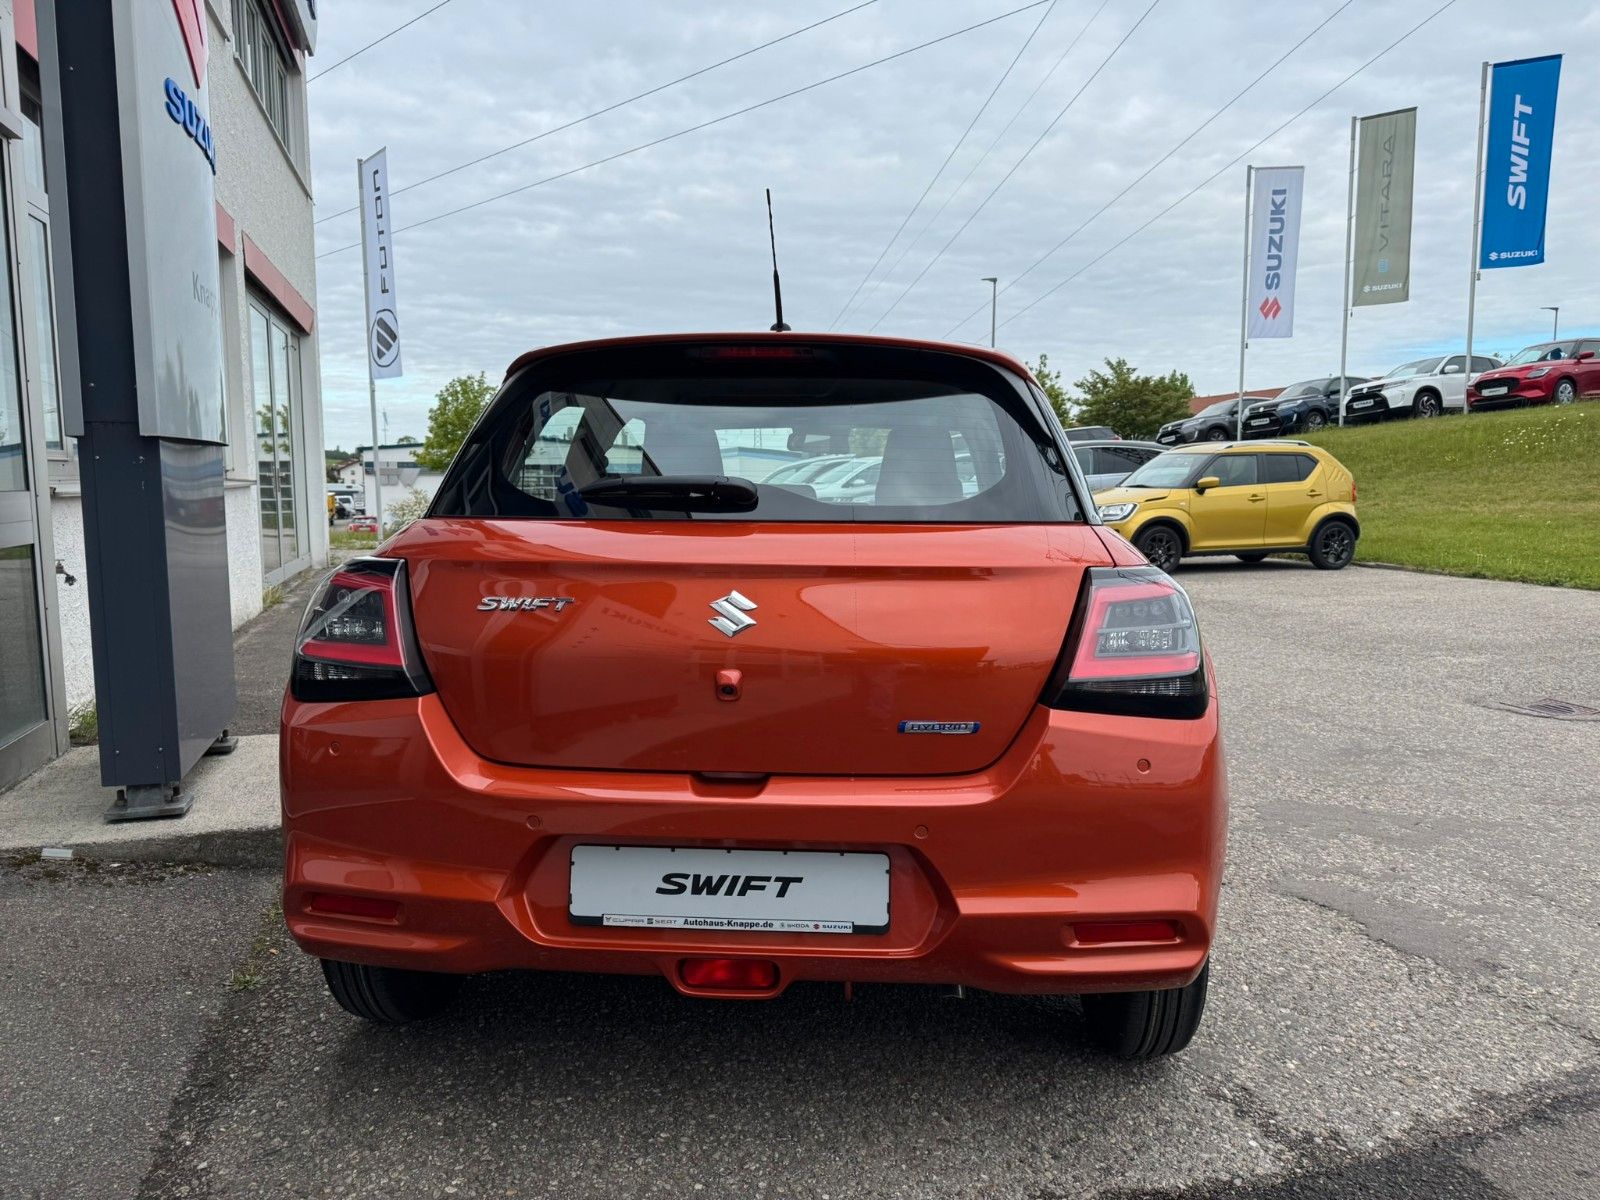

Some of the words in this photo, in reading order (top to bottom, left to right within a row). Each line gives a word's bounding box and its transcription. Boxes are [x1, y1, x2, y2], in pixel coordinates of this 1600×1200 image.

[1507, 94, 1535, 210] SWIFT
[1378, 135, 1394, 252] VITARA
[372, 168, 390, 294] FOTON
[1265, 188, 1287, 290] SUZUKI
[1500, 249, 1538, 259] SUZUKI
[1371, 282, 1403, 291] SUZUKI
[477, 596, 575, 611] SWIFT
[655, 872, 804, 898] SWIFT
[683, 918, 774, 929] Autohaus-Knappe.de
